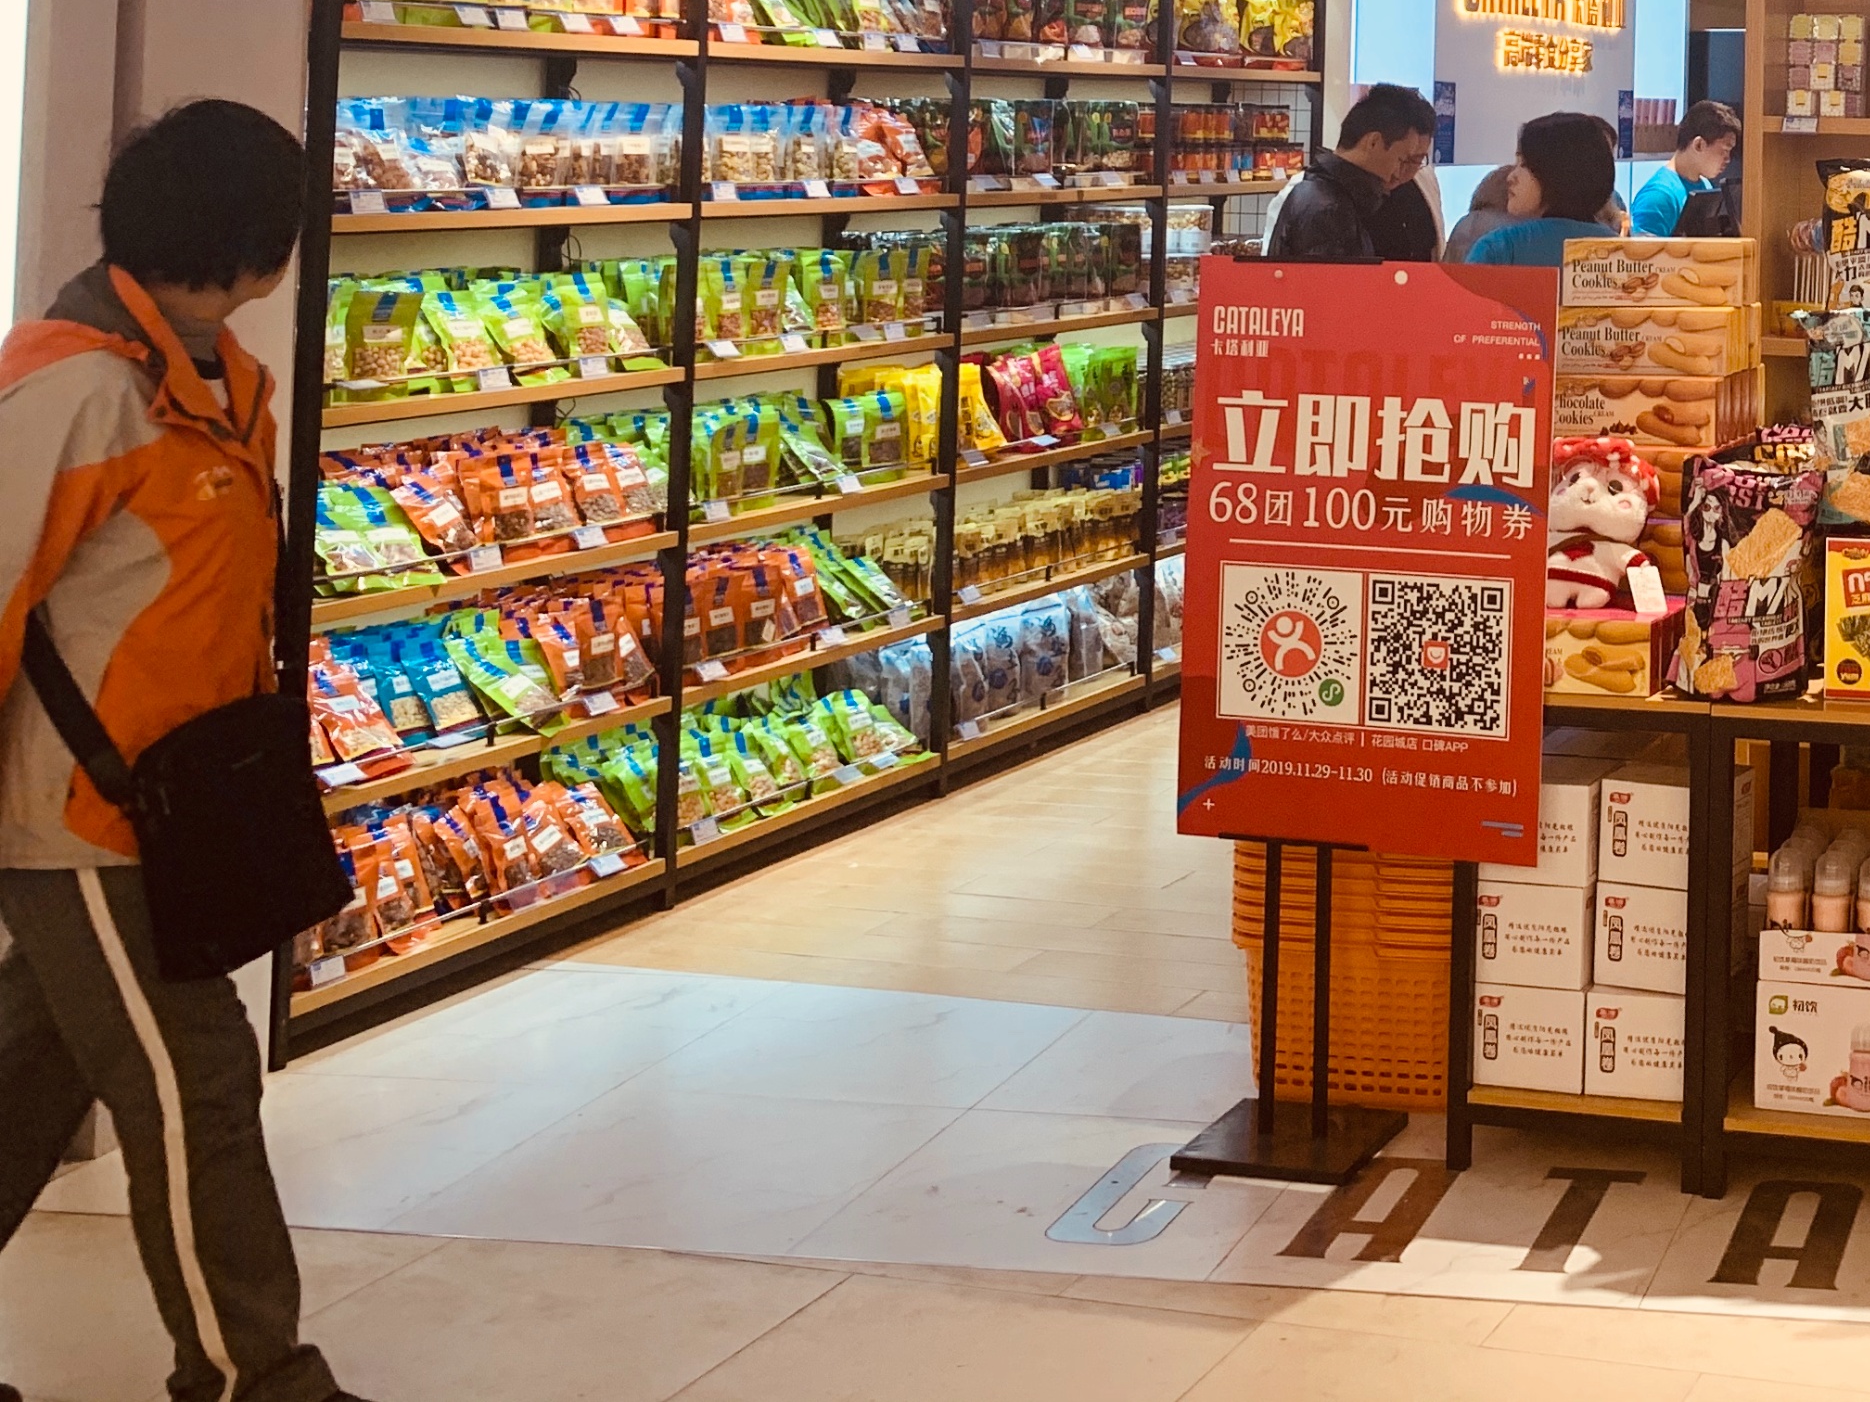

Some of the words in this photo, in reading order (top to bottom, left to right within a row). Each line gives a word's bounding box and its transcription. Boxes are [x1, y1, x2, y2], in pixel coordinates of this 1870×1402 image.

[1572, 258, 1613, 274] Peanut
[1616, 258, 1654, 274] Butter
[1212, 305, 1305, 337] CATALEYA
[1490, 320, 1541, 331] STRENGTH
[1472, 335, 1540, 347] PREFERENTIAL
[1561, 326, 1601, 342] Peanut
[1604, 327, 1641, 342] Butter
[1210, 338, 1269, 358] 卡塔利亚
[1212, 389, 1537, 488] 立即抢购
[1209, 482, 1534, 541] 68团100元购物券
[1371, 734, 1418, 751] 花园城店
[1422, 740, 1469, 753] 口碑APP
[1792, 1000, 1819, 1013] 初饮
